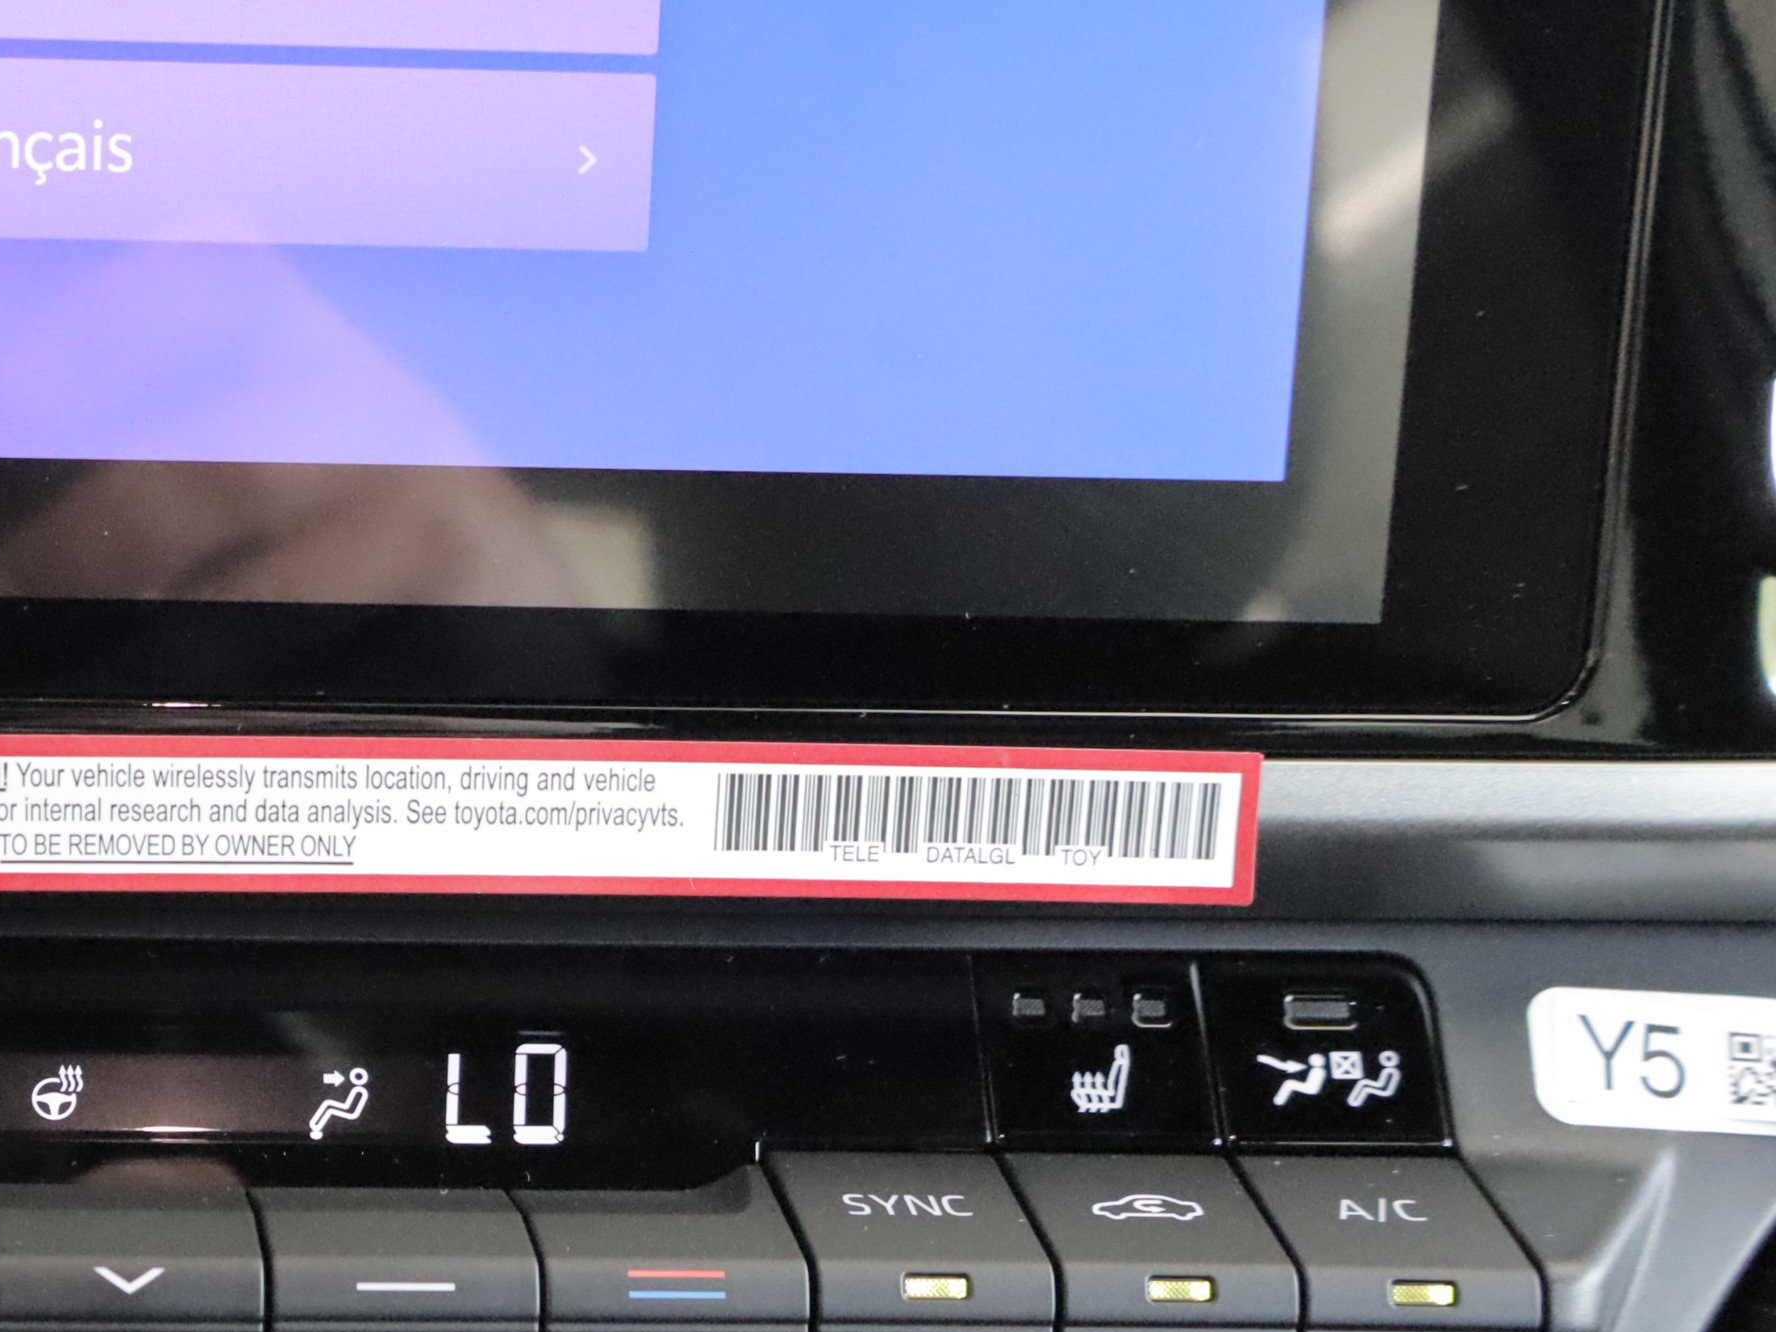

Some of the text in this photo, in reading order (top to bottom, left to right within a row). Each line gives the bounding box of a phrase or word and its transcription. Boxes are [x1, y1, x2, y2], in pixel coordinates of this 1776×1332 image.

[17, 762, 64, 788] Your
[72, 763, 145, 788] vehicle
[153, 764, 255, 794] wirelessly
[263, 764, 358, 790] transmits
[366, 764, 452, 793] location,
[460, 766, 529, 797] driving
[537, 767, 575, 791] and
[584, 768, 656, 792] vehicle
[24, 797, 101, 822] internal
[110, 798, 201, 823] research
[209, 798, 247, 823] and
[255, 798, 300, 823] data
[307, 798, 398, 829] analysis.
[406, 799, 446, 825] See
[454, 800, 684, 832] toyota.com/privacyvts.
[35, 834, 61, 855] BE
[69, 834, 175, 856] REMOVED
[182, 834, 209, 856] BY
[215, 834, 295, 857] OWNER
[301, 835, 356, 857] ONLY
[830, 844, 1102, 866] TELE DATALGL TOY
[1577, 1014, 1687, 1099] Y5
[842, 1193, 974, 1219] SYNC
[1338, 1196, 1429, 1222] A/C
